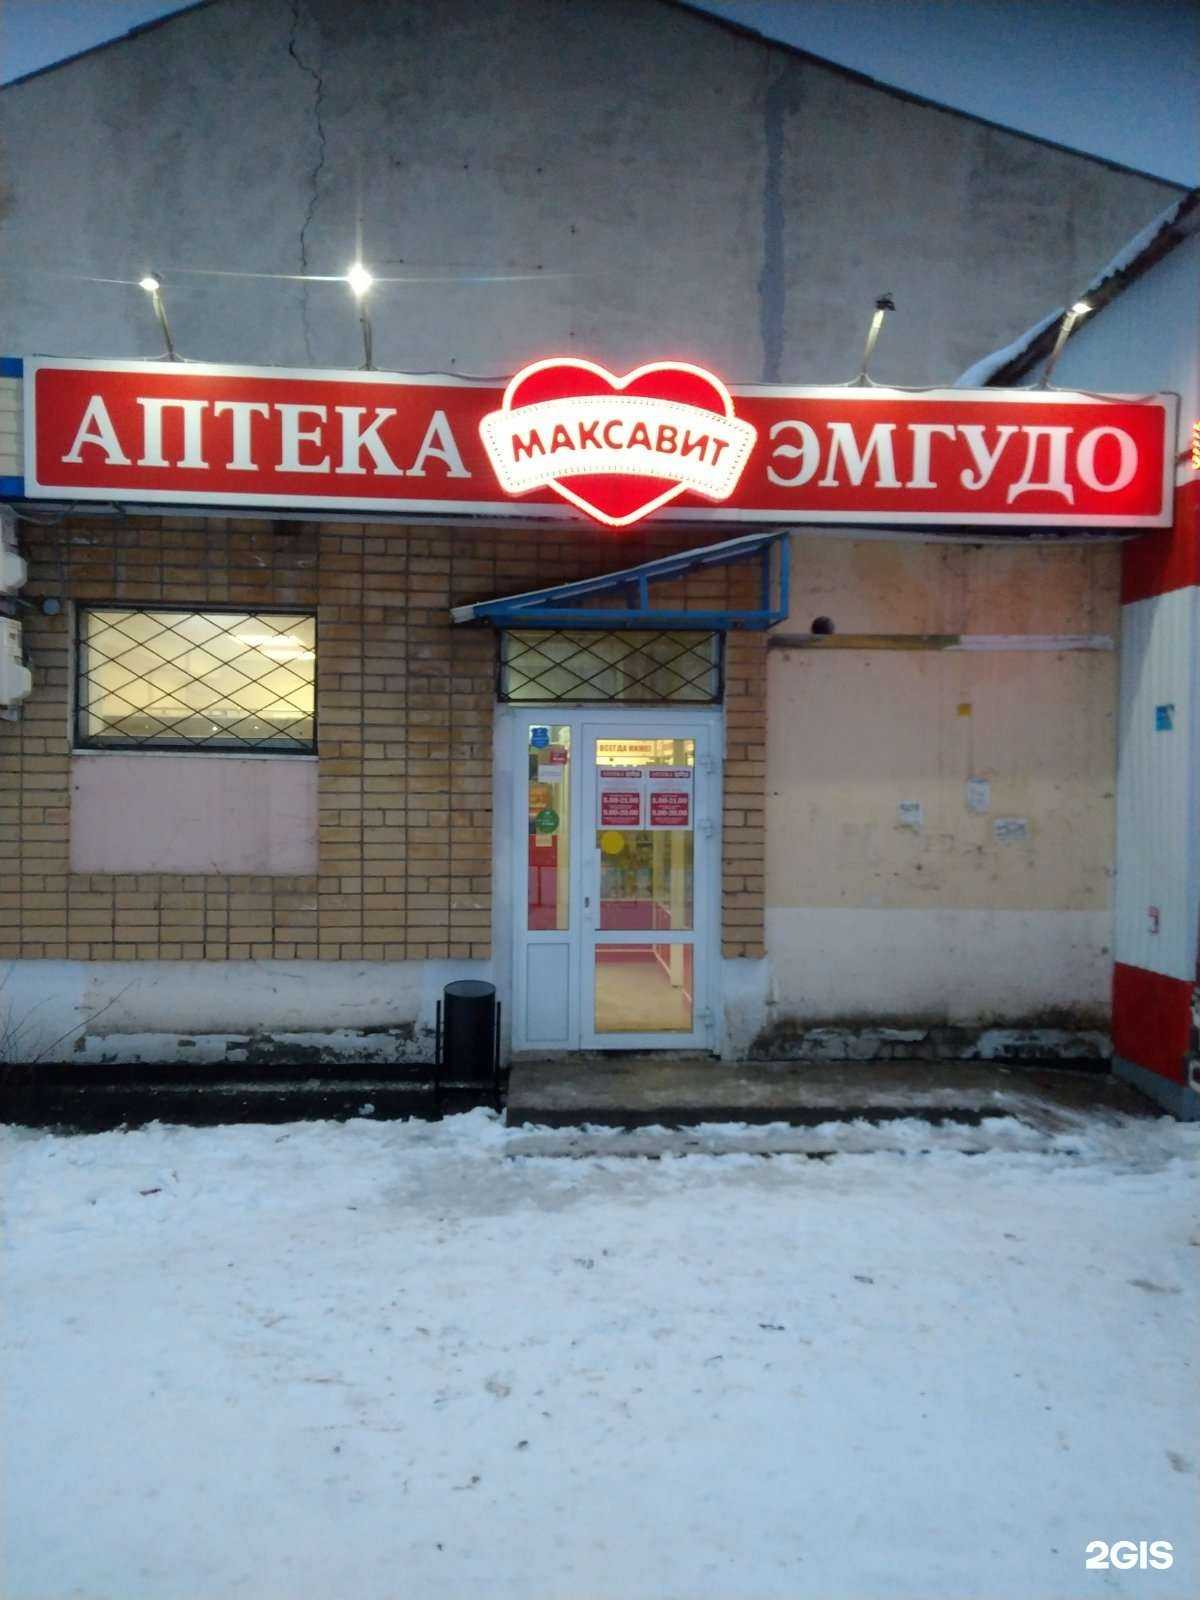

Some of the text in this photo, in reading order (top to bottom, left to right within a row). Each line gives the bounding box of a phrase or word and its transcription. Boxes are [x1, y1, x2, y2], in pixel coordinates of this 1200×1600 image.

[61, 394, 472, 479] АПТЕКА
[511, 418, 731, 468] МАКСАВИТ
[766, 419, 1139, 505] ЭМГУДО
